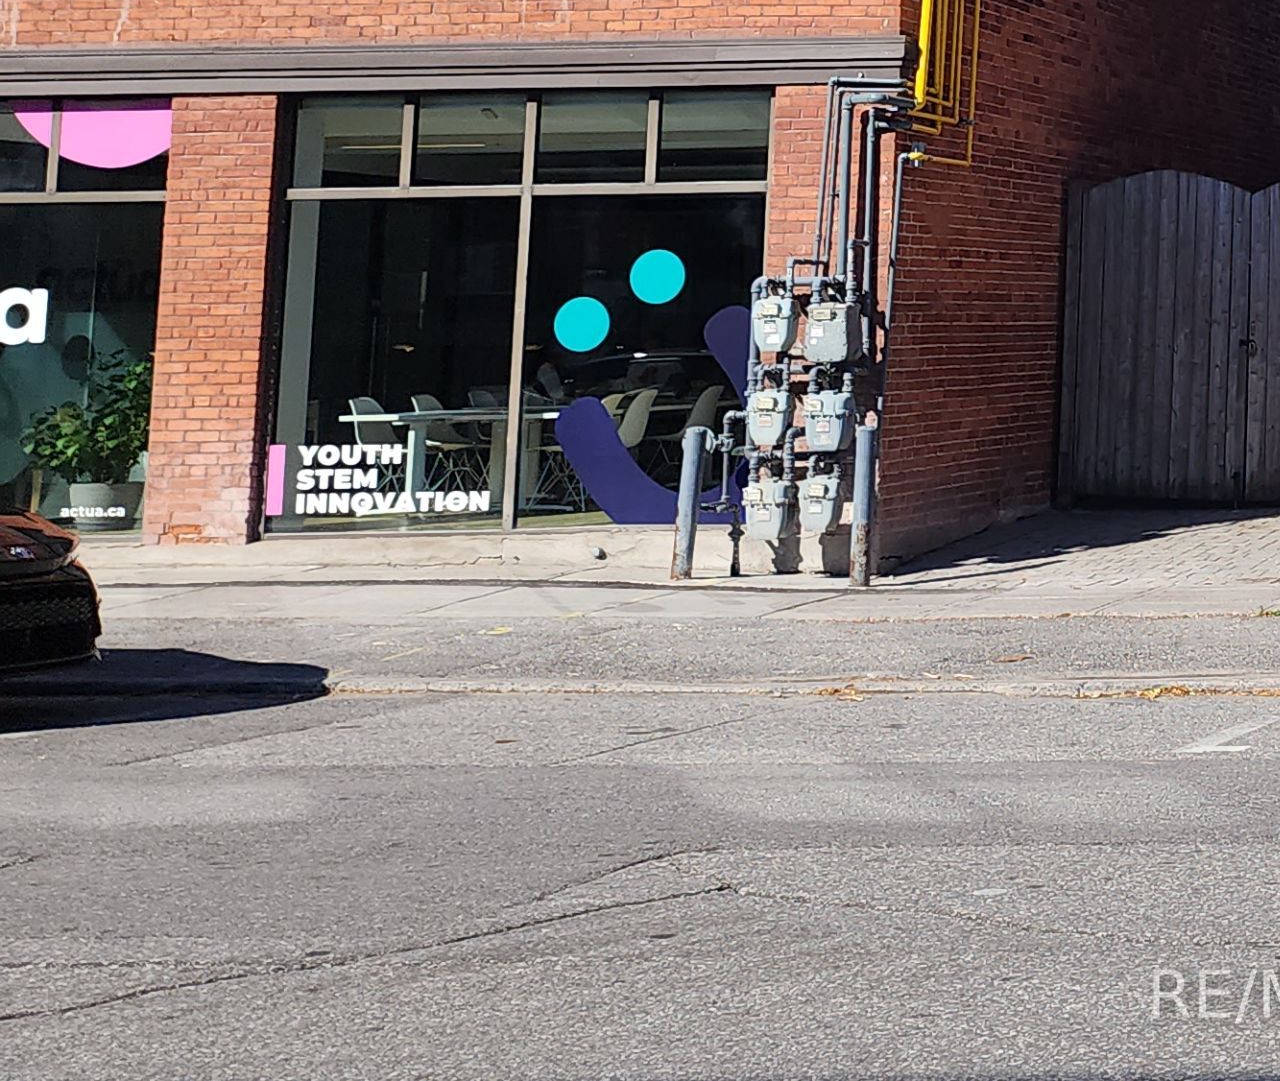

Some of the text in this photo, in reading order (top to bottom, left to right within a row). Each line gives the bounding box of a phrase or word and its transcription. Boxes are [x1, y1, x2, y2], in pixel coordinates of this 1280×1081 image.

[297, 444, 403, 467] YOUTH
[296, 468, 379, 491] STEM
[59, 505, 126, 518] actua.ca
[295, 490, 491, 516] INNOVATION
